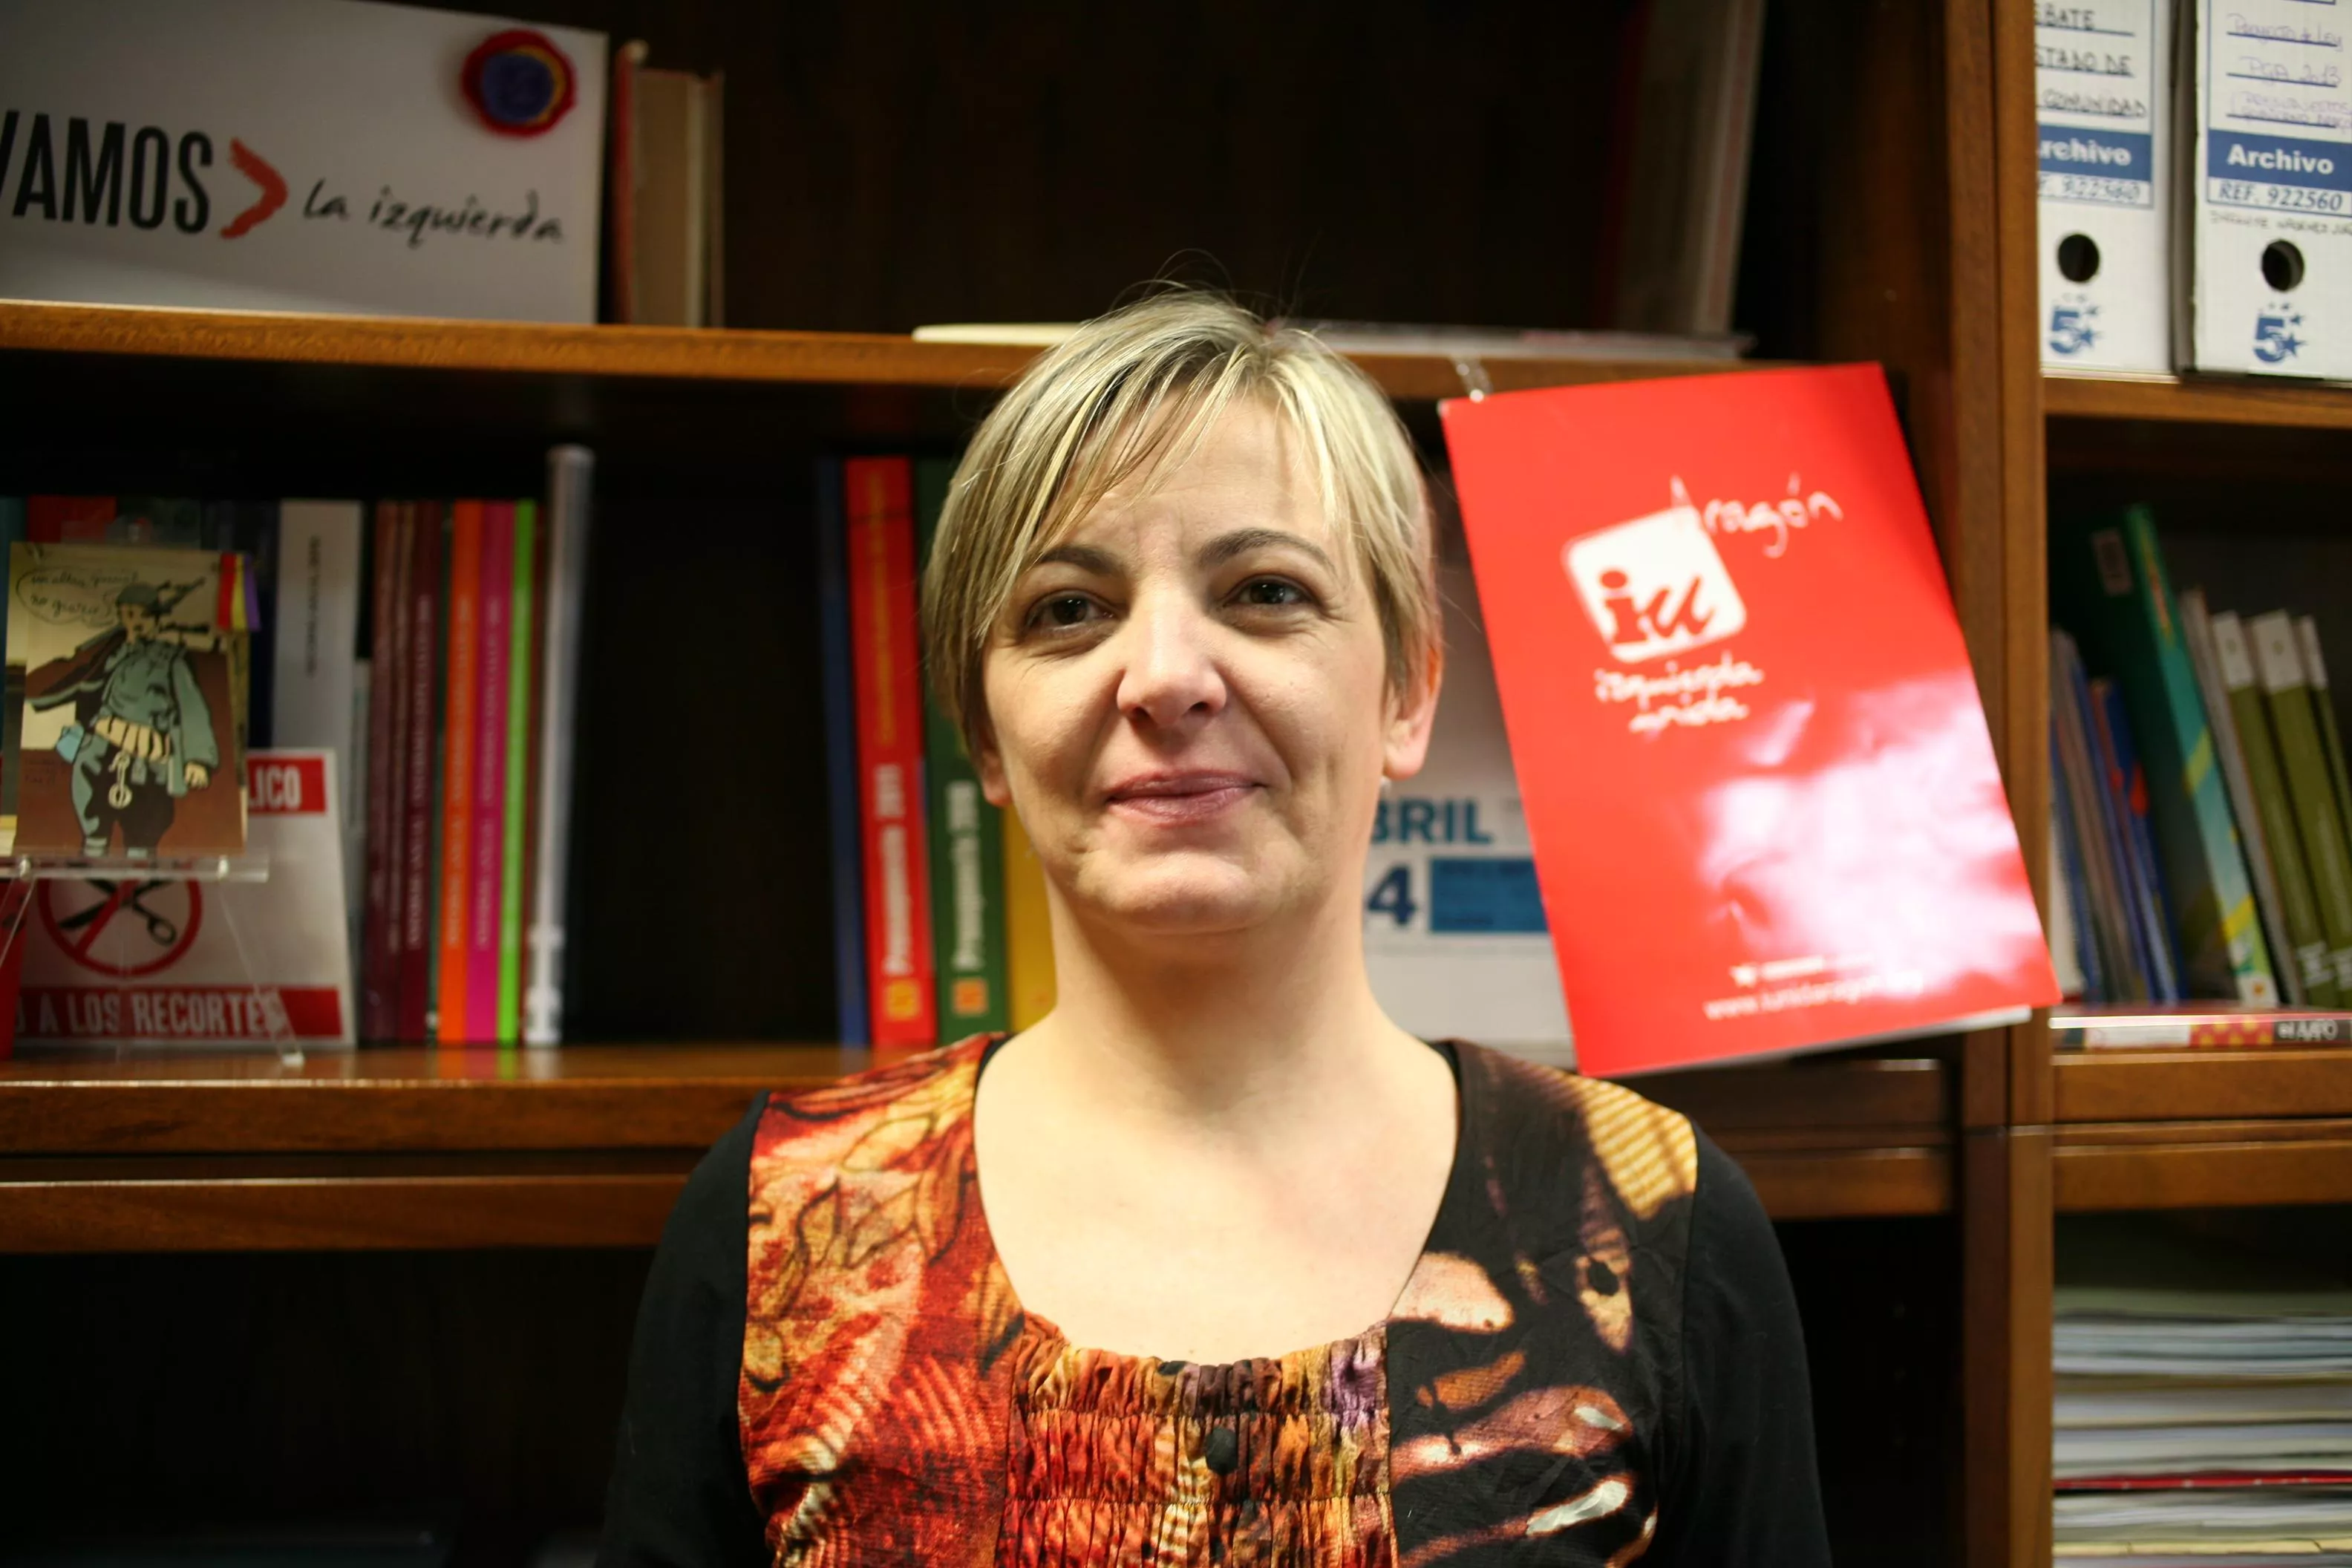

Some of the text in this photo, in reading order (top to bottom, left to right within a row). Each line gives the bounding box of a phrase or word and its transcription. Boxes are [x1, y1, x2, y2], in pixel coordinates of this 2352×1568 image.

[2039, 137, 2132, 166] rchivo
[2228, 145, 2334, 174] Archivo
[2267, 185, 2344, 212] 922560
[368, 186, 566, 249] izquierda
[39, 992, 59, 1033] A
[66, 992, 121, 1033] LOS
